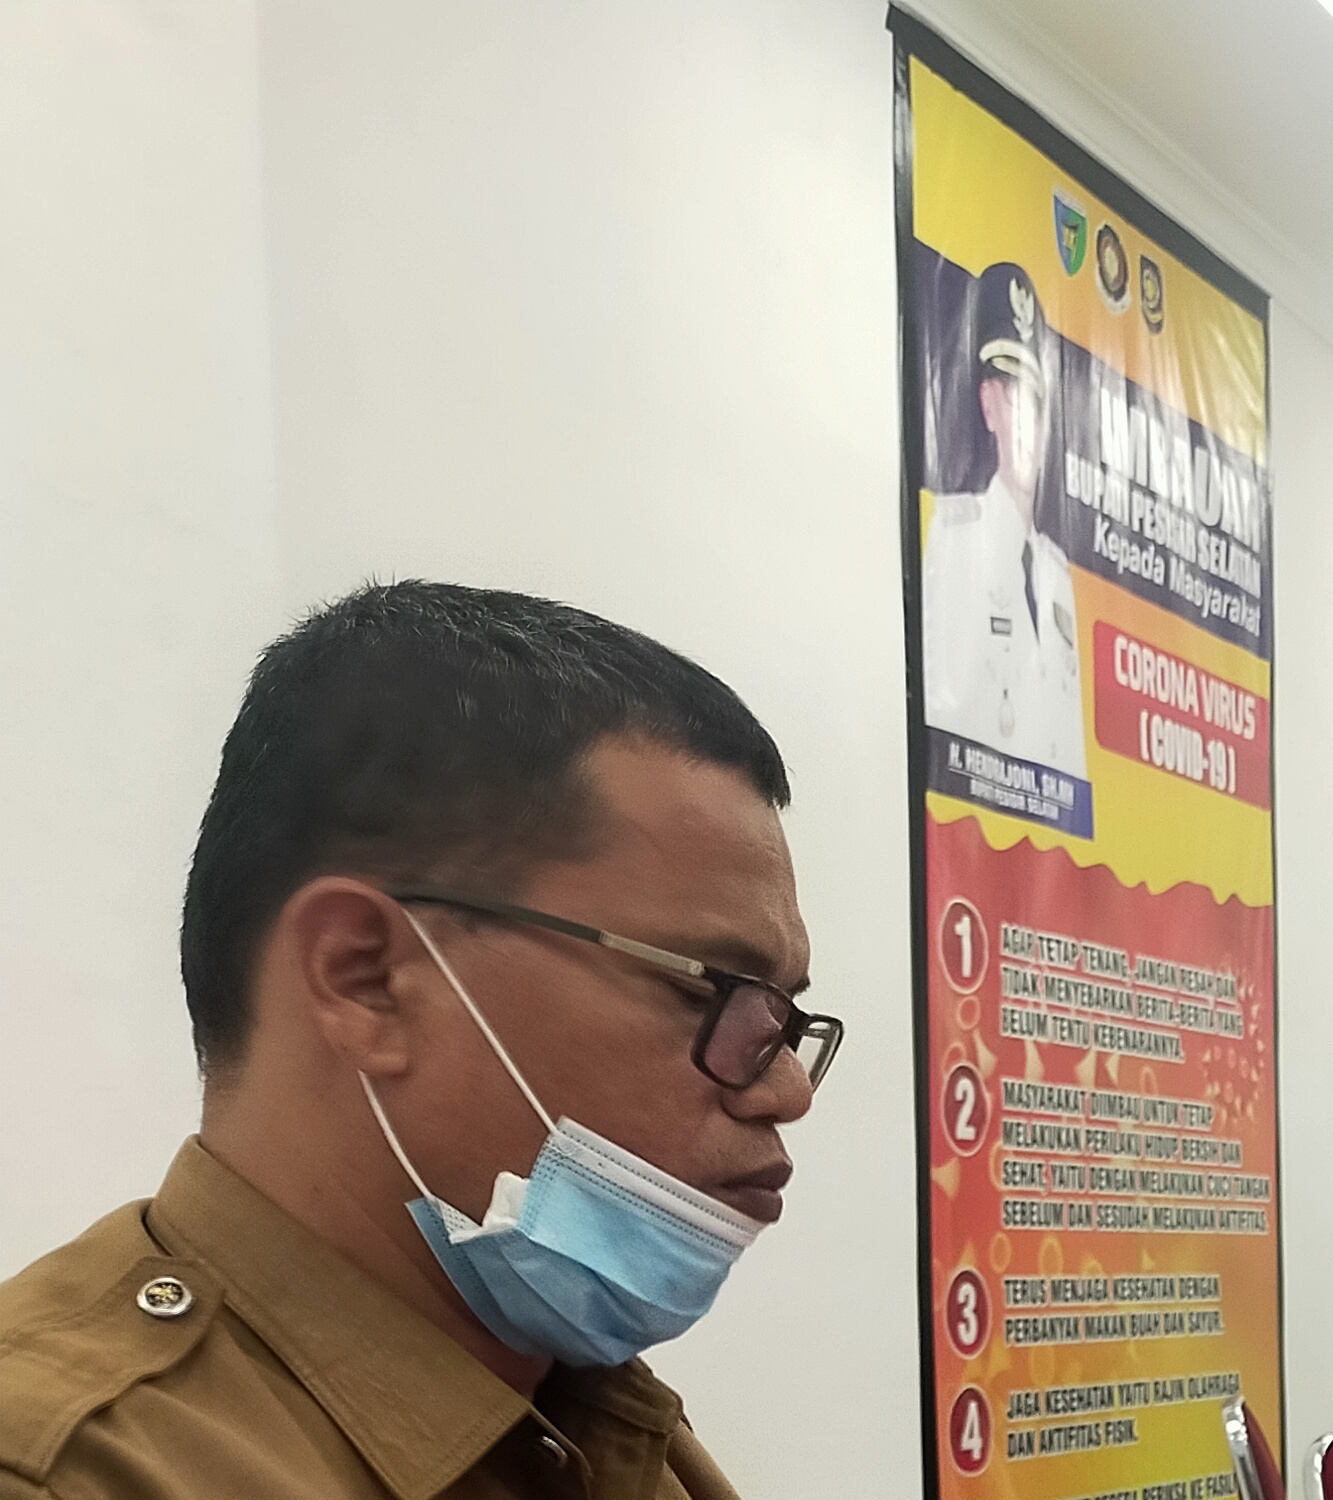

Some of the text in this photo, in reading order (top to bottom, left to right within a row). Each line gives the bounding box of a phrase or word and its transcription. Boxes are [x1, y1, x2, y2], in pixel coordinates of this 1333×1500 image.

[1094, 514, 1260, 637] Kepada Masyarakat
[1114, 635, 1256, 740] CORONA VIRUS
[954, 915, 972, 978] 1
[1002, 926, 1034, 960] AGAR
[1037, 934, 1079, 968] TETAP
[1136, 957, 1177, 989] JANGAN
[1216, 975, 1236, 1002] DAN
[1002, 966, 1041, 999] TIDAK
[1043, 975, 1134, 1017] MENYEBARKAN
[1002, 1006, 1048, 1041] BELUM
[1051, 1015, 1090, 1046] TENTU
[954, 1078, 976, 1141] 2
[1003, 1080, 1085, 1116] MASYARAKAT
[1144, 1099, 1178, 1125] UNTUK
[1181, 1103, 1214, 1129] TETAP
[1003, 1121, 1082, 1153] MELAKUKAN
[1085, 1128, 1142, 1157] PERILAKU
[1145, 1135, 1179, 1161] HIDUP
[1221, 1142, 1242, 1166] DAN
[1051, 1163, 1086, 1191] YAITU
[1089, 1166, 1136, 1194] DENGAN
[1138, 1171, 1204, 1198] MELAKUKAN
[1207, 1174, 1231, 1200] CUCI
[1232, 1176, 1270, 1200] TANGAN
[1003, 1200, 1064, 1228] SEBELUM
[1068, 1203, 1093, 1228] DAN
[1096, 1204, 1148, 1231] SESUDAH
[1152, 1206, 1216, 1232] MELAKUKAN
[957, 1283, 977, 1345] 3
[1004, 1276, 1220, 1305] TERUS MENJAGA KESEHATAN DENGAN
[1005, 1316, 1081, 1345] PERBANYAK
[1085, 1315, 1127, 1341] MAKAN
[1131, 1313, 1160, 1337] BUAH
[1163, 1312, 1184, 1335] DAN
[1007, 1372, 1240, 1420] JAGA KESEHATAN YAITU RAJIN OLAHRAGA
[961, 1402, 982, 1461] 4
[1007, 1431, 1036, 1459] DAN
[1039, 1423, 1101, 1455] AKTIFITAS
[1190, 1478, 1204, 1500] KE
